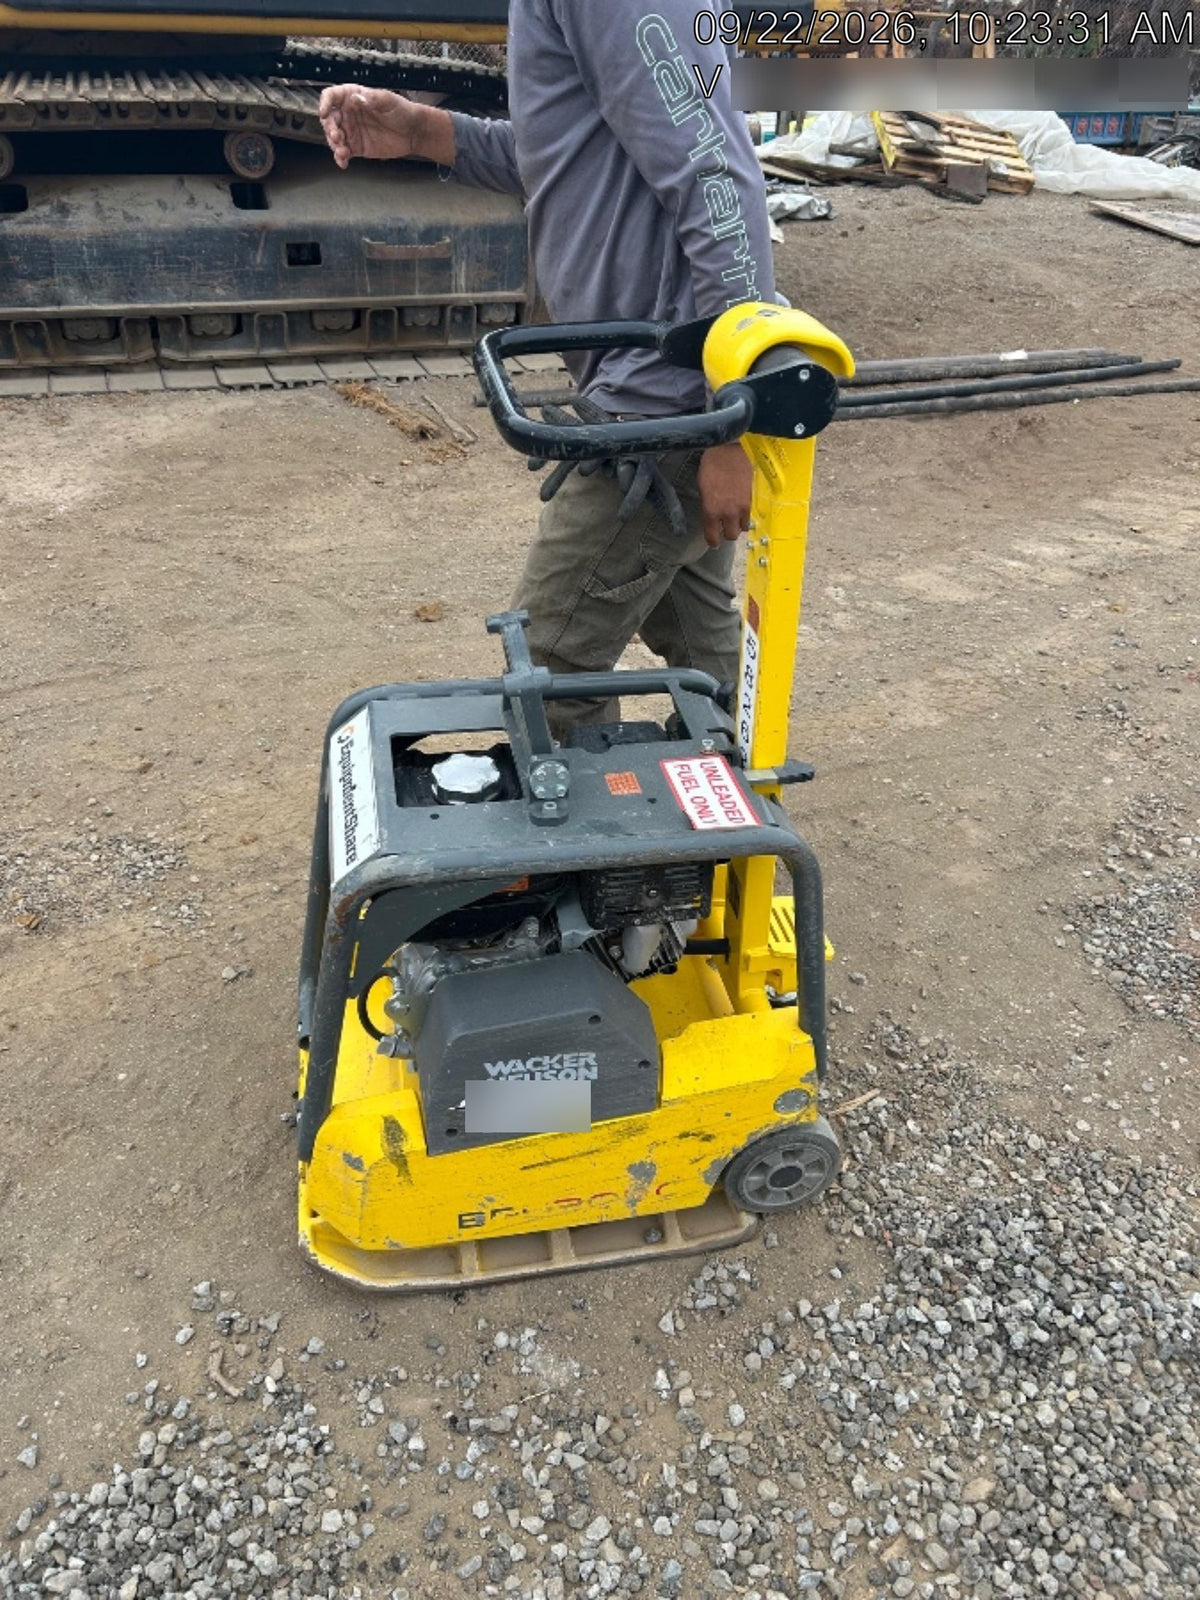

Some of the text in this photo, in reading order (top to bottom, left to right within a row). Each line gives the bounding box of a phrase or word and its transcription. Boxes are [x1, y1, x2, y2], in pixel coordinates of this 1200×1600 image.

[674, 763, 701, 793] FUEL
[699, 761, 746, 824] UNLEADED
[483, 1052, 598, 1077] WACKER
[486, 1066, 598, 1081] USON
